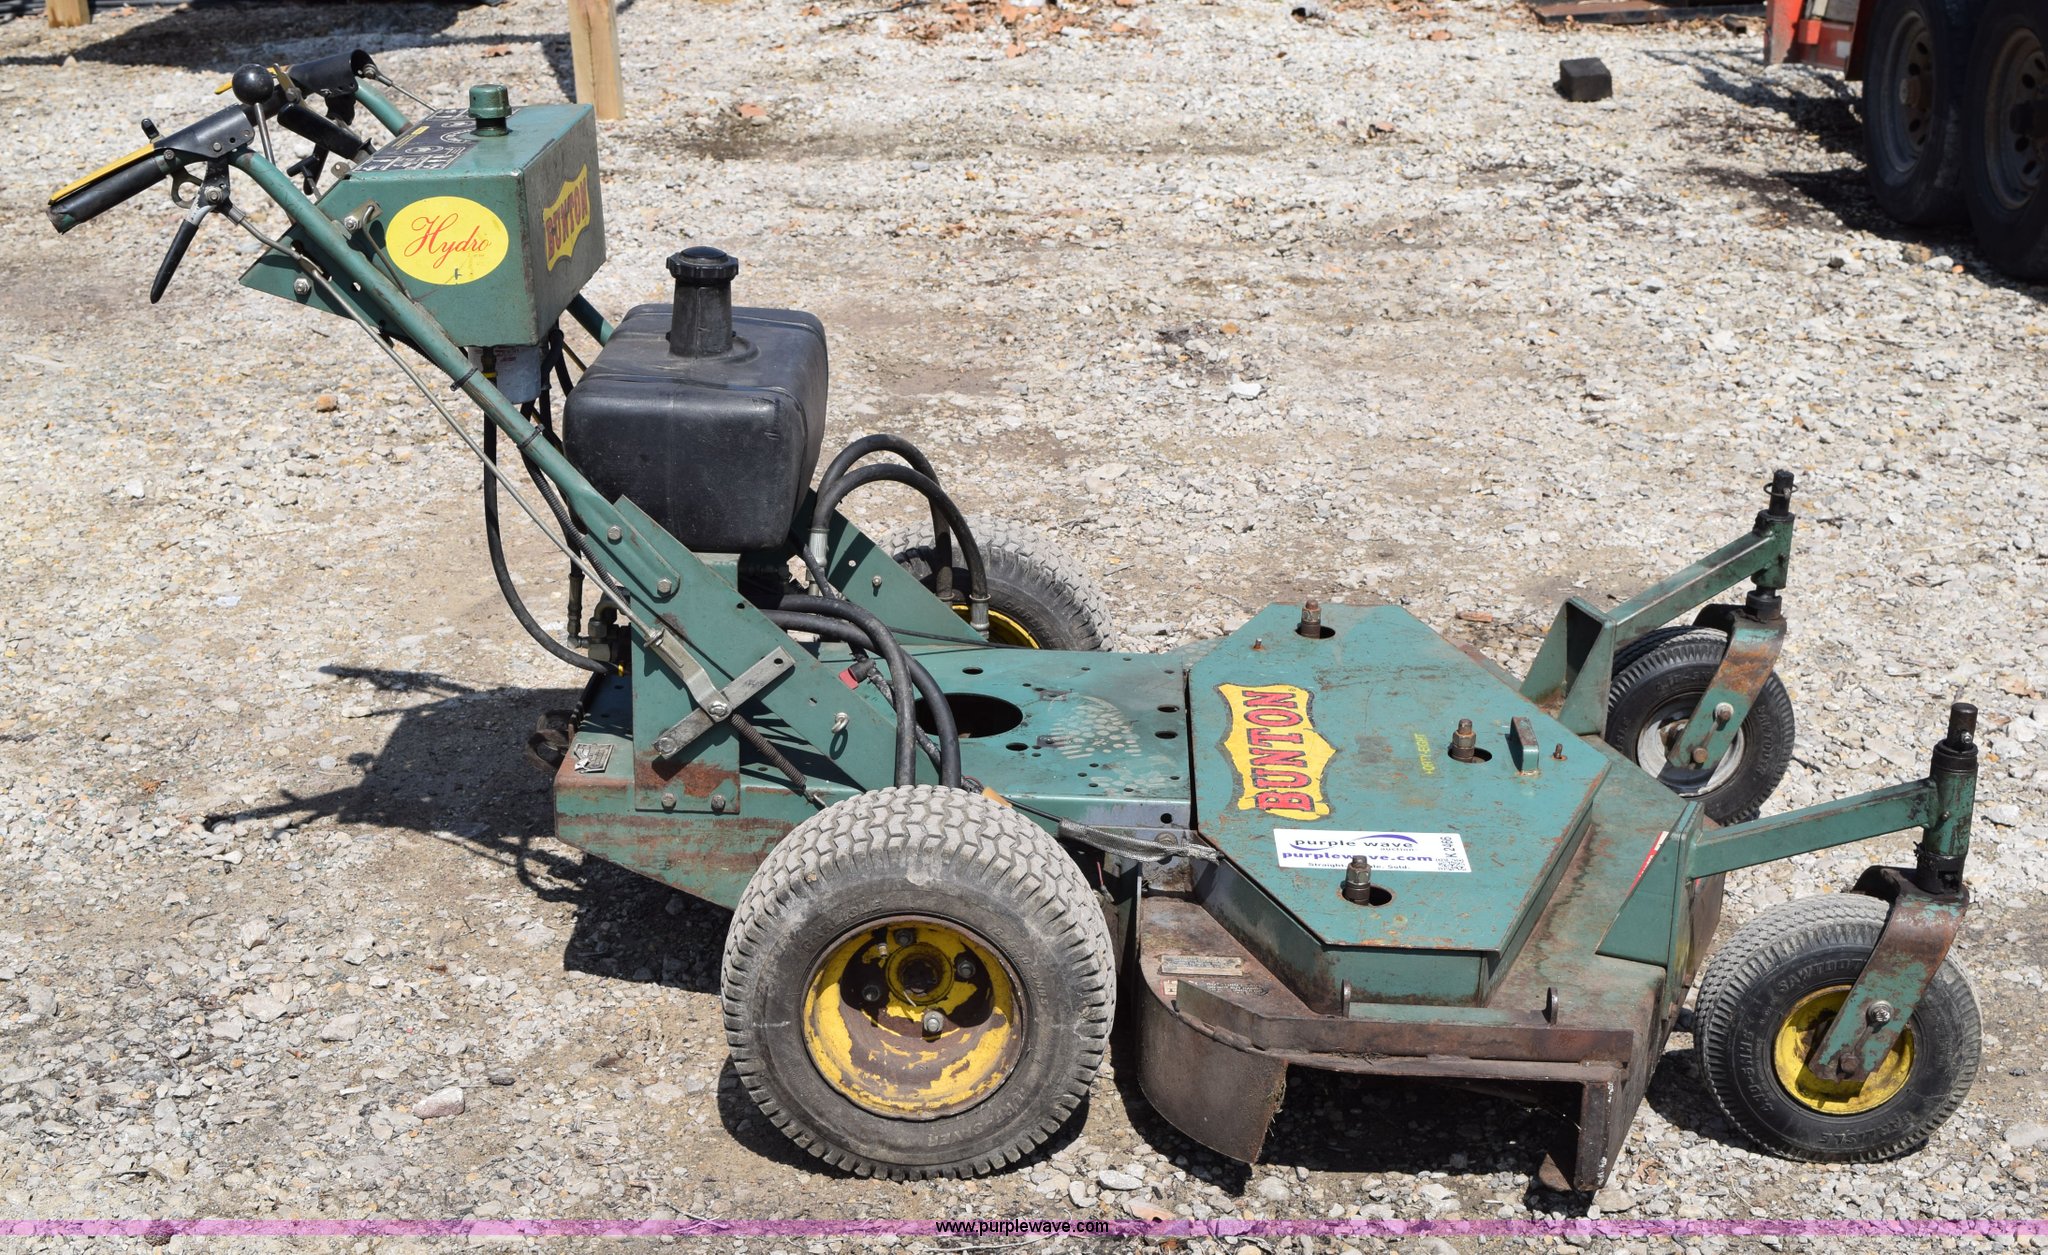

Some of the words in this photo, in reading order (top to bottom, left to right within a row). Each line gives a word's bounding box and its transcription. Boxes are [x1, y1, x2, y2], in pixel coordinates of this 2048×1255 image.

[403, 212, 492, 269] Hydro
[546, 177, 589, 261] BUNTON
[1241, 690, 1315, 812] BUNTON
[1282, 852, 1433, 862] purplewve.com
[1294, 838, 1356, 848] purple
[1777, 957, 1867, 993] SAWTOOT
